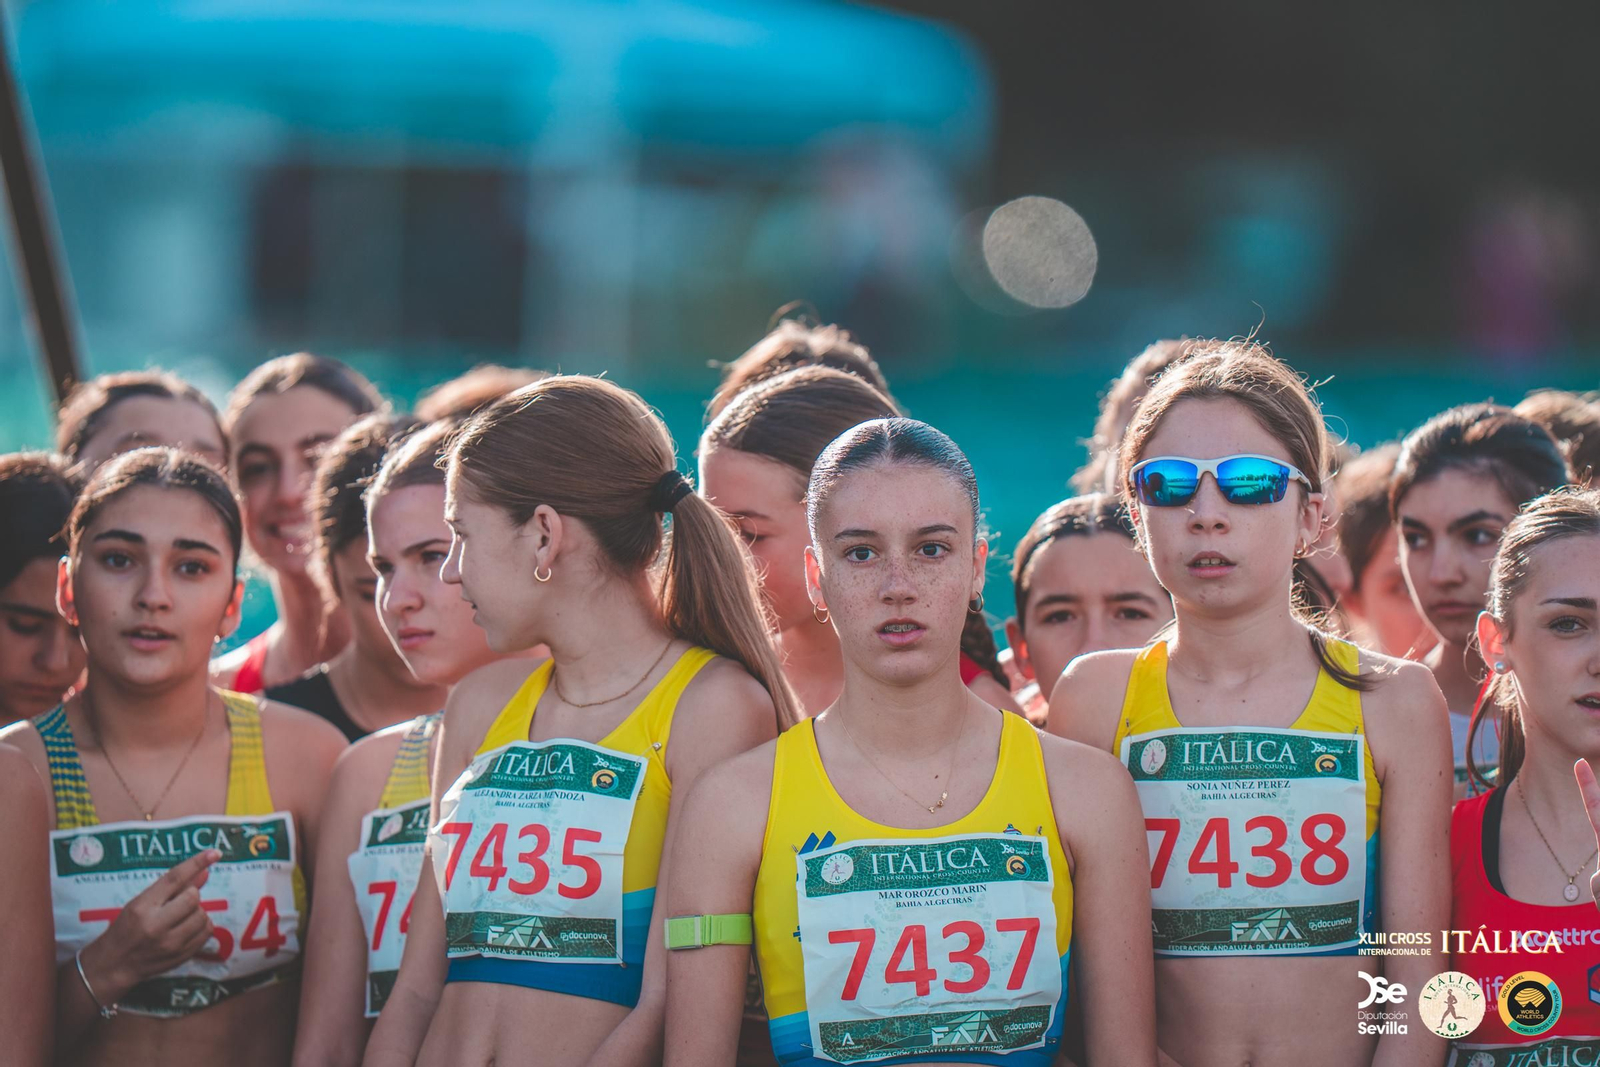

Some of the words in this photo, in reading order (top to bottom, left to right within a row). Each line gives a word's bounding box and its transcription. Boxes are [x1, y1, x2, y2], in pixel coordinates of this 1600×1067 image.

[1182, 735, 1297, 764] ITÁLICA
[493, 750, 576, 777] ITÁLICA
[1264, 763, 1297, 771] COUNTRY
[1187, 782, 1218, 791] SONIA
[1221, 780, 1255, 790] NUÑEZ
[1257, 780, 1291, 789] PEREZ
[474, 789, 517, 800] ALEJANDRA
[519, 791, 542, 800] ZARZA
[543, 791, 585, 801] MENDOZA
[1228, 791, 1277, 800] ALGECIRAS
[120, 827, 233, 857] ITÁLICA
[1145, 813, 1349, 889] 7438
[441, 822, 603, 899] 7435
[871, 846, 990, 875] ITÁLICA
[874, 873, 931, 882] INTERNATIONAL
[932, 870, 955, 879] CROSS
[957, 868, 991, 876] COUNTRY
[878, 890, 903, 900] MAR
[904, 886, 950, 899] OROZCO
[952, 884, 987, 895] MARIN
[924, 896, 973, 907] ALGECIRAS
[1316, 917, 1352, 929] docunova
[568, 931, 608, 941] docunova
[1168, 942, 1210, 951] FEDERACIÓN
[1213, 943, 1254, 951] ANDALUZA
[1268, 942, 1310, 950] ATLETISMO
[520, 950, 560, 958] ATLETISMO
[828, 917, 1040, 1000] 7437
[1009, 1021, 1043, 1031] docunova
[865, 1048, 910, 1059] FEDERACIÓN
